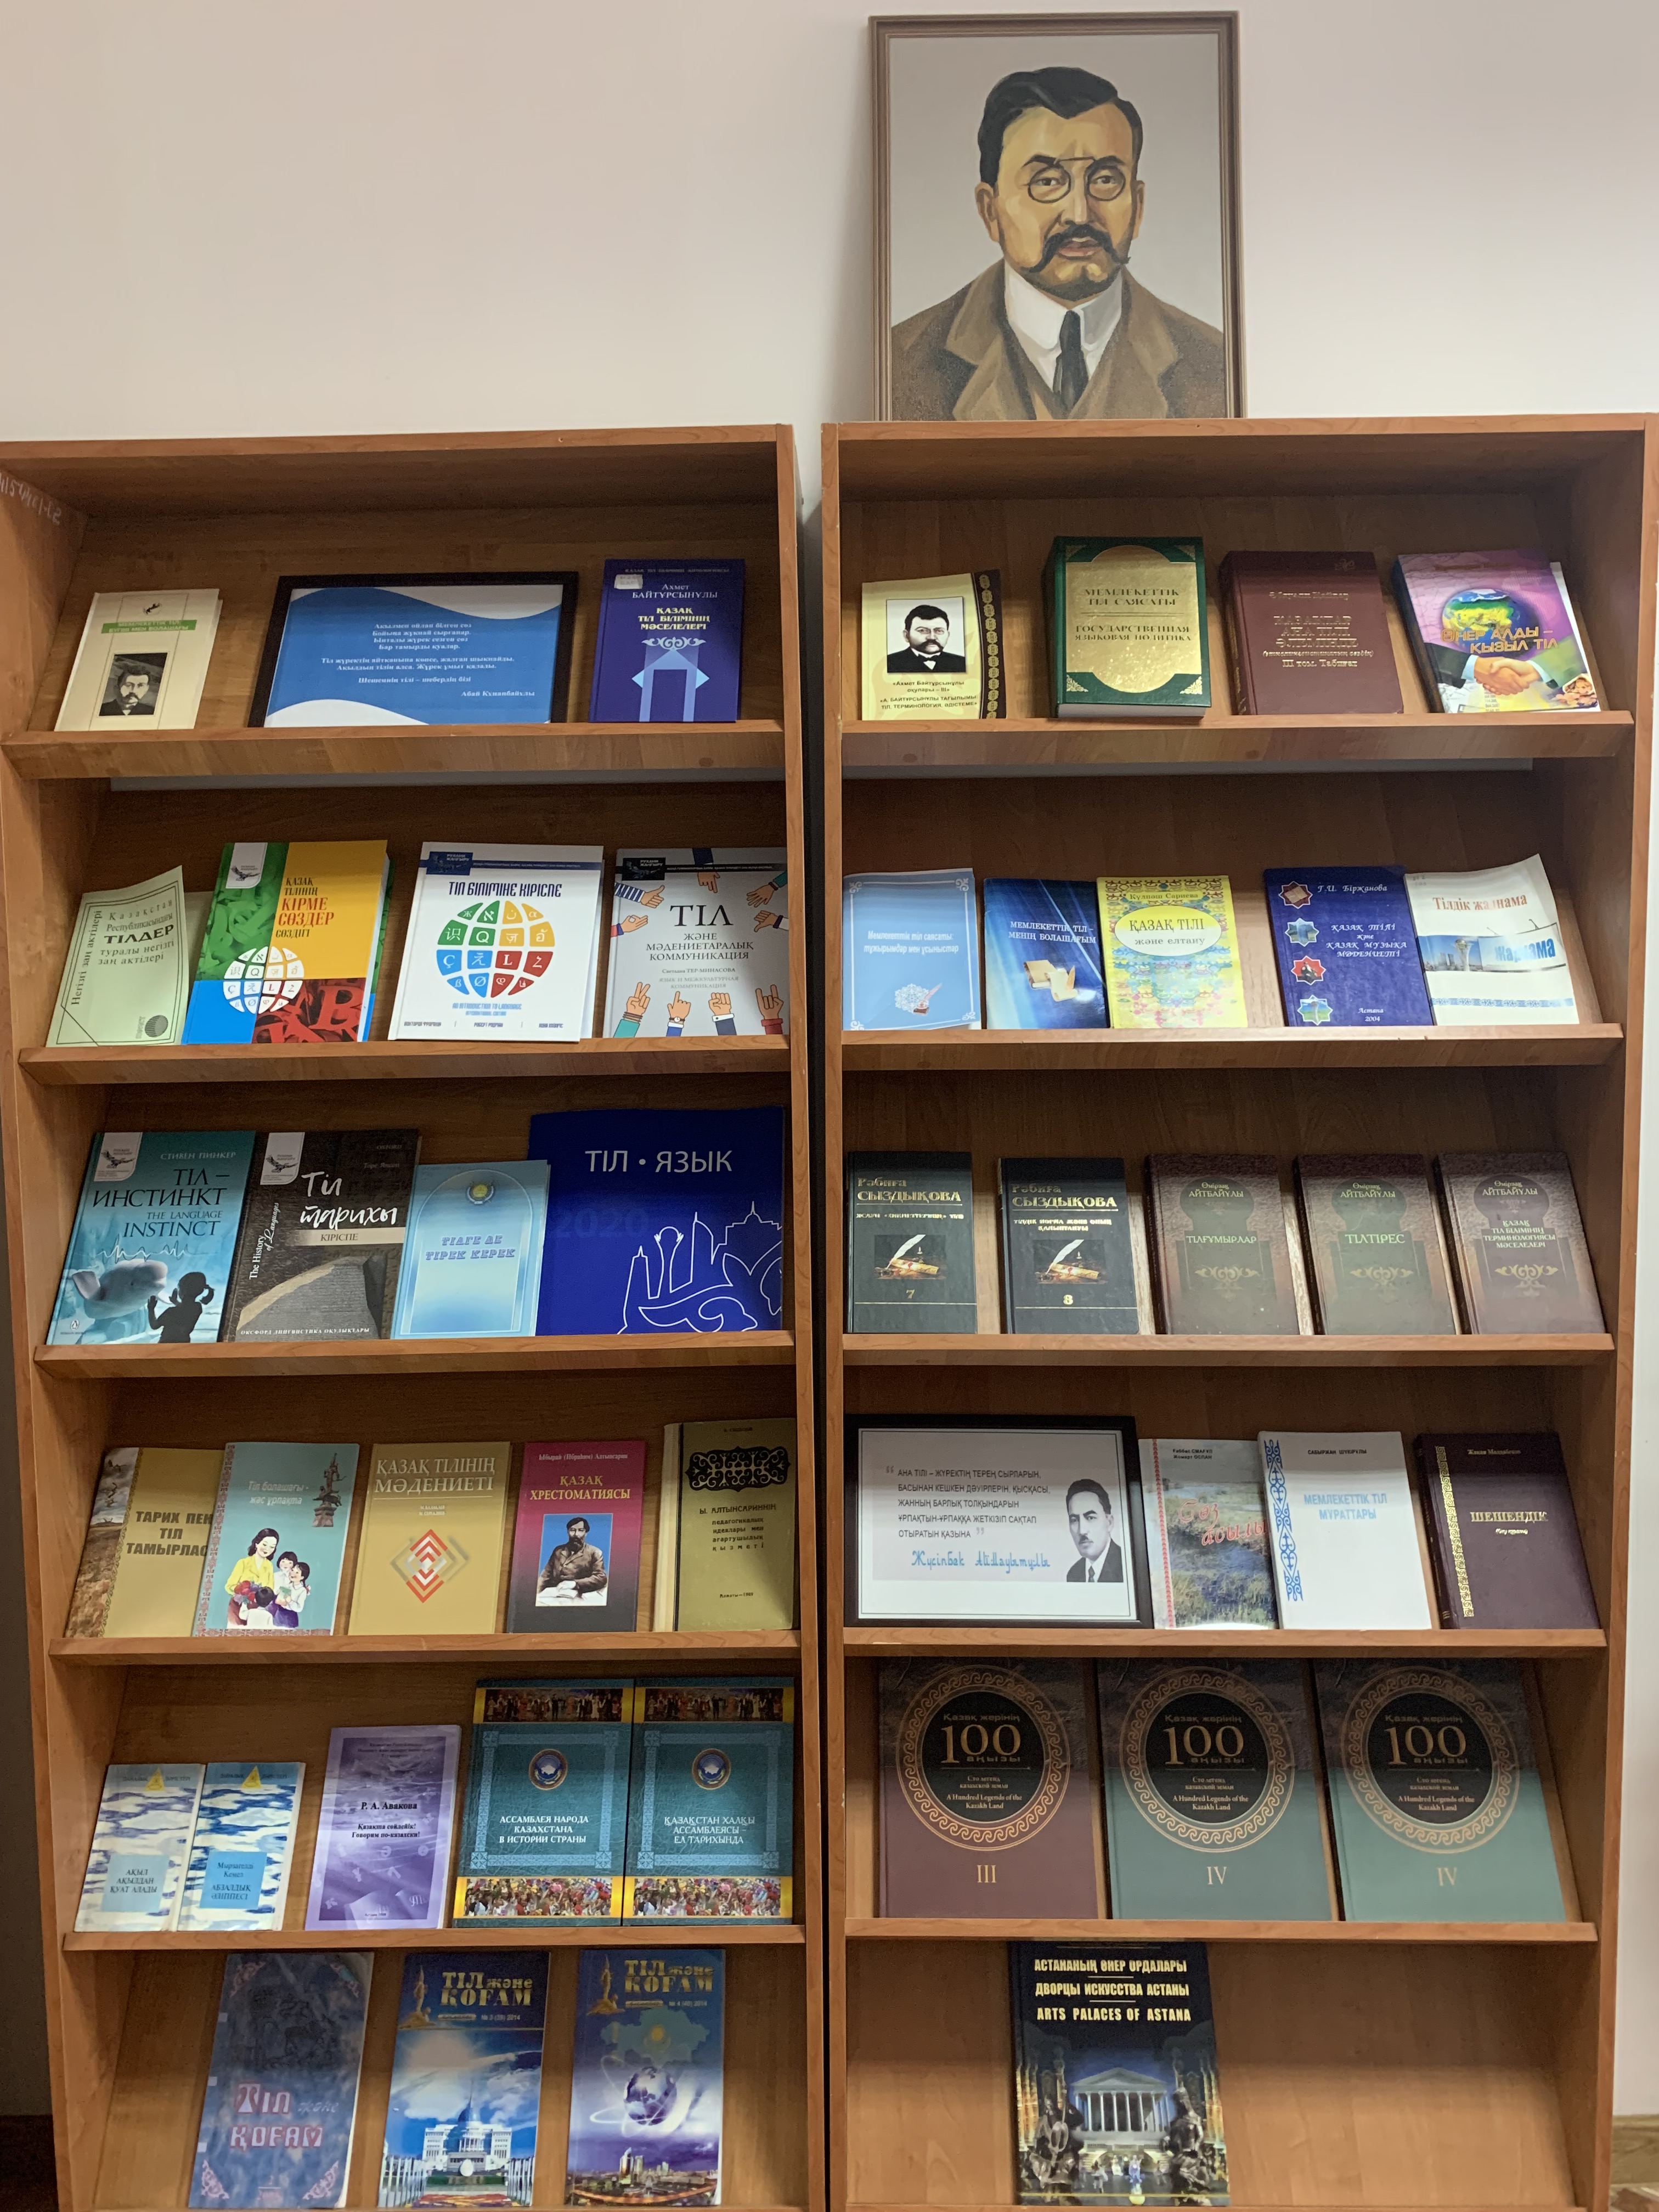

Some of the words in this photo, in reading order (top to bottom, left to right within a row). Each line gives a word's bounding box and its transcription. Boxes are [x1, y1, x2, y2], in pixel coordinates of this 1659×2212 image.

[1075, 625, 1190, 633] ГОСУДАРСТВЕННАЯ
[1441, 628, 1486, 642] ӨНЕР
[1490, 626, 1539, 640] АЛДЫ
[285, 877, 314, 887] ҚАЗАҚ
[281, 897, 329, 911] КІРМЕ
[278, 911, 335, 929] СӨЗДЕР
[669, 905, 734, 927] ТІЛ
[1010, 921, 1070, 932] МЕМЛЕКЕТТІК
[1072, 925, 1088, 933] ТІЛ
[1129, 919, 1175, 934] ҚАЗАҚ
[1177, 918, 1205, 930] ТІЛІ
[104, 924, 174, 944] ТІЛДЕР
[275, 929, 311, 939] СӨЗДІГІ
[476, 930, 489, 944] Q
[100, 947, 139, 957] туралы
[144, 938, 174, 952] негізгі
[646, 941, 754, 951] МӘДЕНИЕТАРАЛЫҚ
[1167, 937, 1206, 946] елтану
[1325, 941, 1360, 951] ҚАЗАҚ
[1363, 941, 1408, 949] МУЗЫКА
[650, 951, 749, 961] КОММУНИКАЦИЯ
[1336, 950, 1401, 958] МӘДЕНИЕТІ
[198, 1152, 236, 1160] ПИНКЕР
[584, 1150, 628, 1173] ТІЛ
[654, 1150, 733, 1173] ЯЗЫК
[172, 1168, 210, 1186] ТІЛ
[301, 1171, 343, 1198] Тіл
[92, 1187, 228, 1207] ИНСТИНКТ
[856, 1190, 962, 1204] СЫЗДЫҚОВА
[1012, 1197, 1118, 1209] СЫЗДЫҚОВА
[146, 1211, 166, 1220] THE
[170, 1210, 223, 1220] LANGUAGE
[300, 1205, 398, 1231] тарихы
[122, 1221, 221, 1238] INSTINCT
[320, 1233, 359, 1242] КІРІСПЕ
[251, 1234, 267, 1263] History
[425, 1250, 467, 1261] ТІРЕК
[470, 1248, 516, 1260] КЕРЕК
[249, 1265, 261, 1280] The
[906, 1289, 916, 1300] 7
[1063, 1294, 1074, 1306] 8
[376, 1459, 430, 1477] ҚАЗАҚ
[434, 1457, 496, 1475] ТІЛІНІҢ
[934, 1469, 972, 1479] ЖҮРЕКТІҢ
[972, 1470, 997, 1479] ТЕРЕҢ
[998, 1470, 1041, 1479] СЫРЛАРЫН,
[374, 1476, 494, 1496] МӘДЕНИЕТІ
[559, 1475, 603, 1487] ҚАЗАҚ
[529, 1488, 631, 1500] ХРЕСТОМАТИЯСЫ
[898, 1484, 934, 1492] БАСЫНАН
[898, 1499, 932, 1509] ЖАННЫҢ
[933, 1499, 962, 1509] БАРЛЫҚ
[963, 1500, 1019, 1509] ТОЛҚЫНДАРЫН
[1303, 1493, 1370, 1505] МЕМЛЕКЕТТІК
[1372, 1493, 1388, 1504] ТІЛ
[136, 1510, 180, 1524] ТАРИХ
[185, 1513, 213, 1525] ПЕН
[1319, 1509, 1377, 1520] МҰРАТТАРЫ
[1470, 1511, 1548, 1523] ШЕШЕНДІК
[160, 1528, 183, 1540] ТІЛ
[898, 1530, 939, 1538] ОТЫРАТЫН
[941, 1530, 971, 1539] ҚАЗЫНА
[940, 1724, 1022, 1764] 100
[1163, 1725, 1244, 1765] 100
[1384, 1725, 1466, 1765] 100
[360, 1802, 368, 1810] Р.
[370, 1802, 380, 1810] А.
[499, 1815, 551, 1824] АССАМБЛЕЯ
[553, 1815, 589, 1824] НАРОДА
[664, 1816, 720, 1826] ҚАЗАҚСТАН
[722, 1816, 755, 1826] ХАЛҚЫ
[672, 1826, 740, 1834] АССАМБЛЕЯСЫ
[550, 1835, 587, 1843] СТРАНЫ
[674, 1836, 686, 1844] ЕЛ
[689, 1836, 744, 1844] ТАРИХЫНДА
[125, 1868, 149, 1877] АҚЫЛ
[977, 1864, 997, 1883] III
[1207, 1866, 1227, 1885] IV
[1436, 1867, 1457, 1886] IV
[116, 1877, 155, 1886] АҚЫЛДАН
[110, 1886, 129, 1894] ҚУАТ
[131, 1886, 158, 1894] АЛАДЫ
[211, 1883, 251, 1893] АБЗАЛДЫҚ
[624, 1960, 665, 1976] ТІЛ
[668, 1966, 714, 1976] және
[1034, 1959, 1098, 1974] АСТАНАНЫҢ
[1101, 1960, 1126, 1972] ӨНЕР
[1128, 1959, 1188, 1973] ОРДАЛАРЫ
[442, 1972, 484, 1989] ТІЛ
[486, 1977, 533, 1989] және
[624, 1976, 713, 1994] ҚОҒАМ
[1035, 1983, 1081, 1997] ДВОРЦЫ
[1084, 1982, 1143, 1996] ИСКУССТВА
[1146, 1983, 1189, 1996] АСТАНЫ
[441, 1989, 532, 2009] ҚОҒАМ
[1036, 2007, 1066, 2021] ARTS
[1073, 2007, 1122, 2021] PALACES
[1126, 2007, 1140, 2021] OF
[1147, 2007, 1192, 2022] ASTANA
[230, 2125, 324, 2151] ҚОҒАМ
